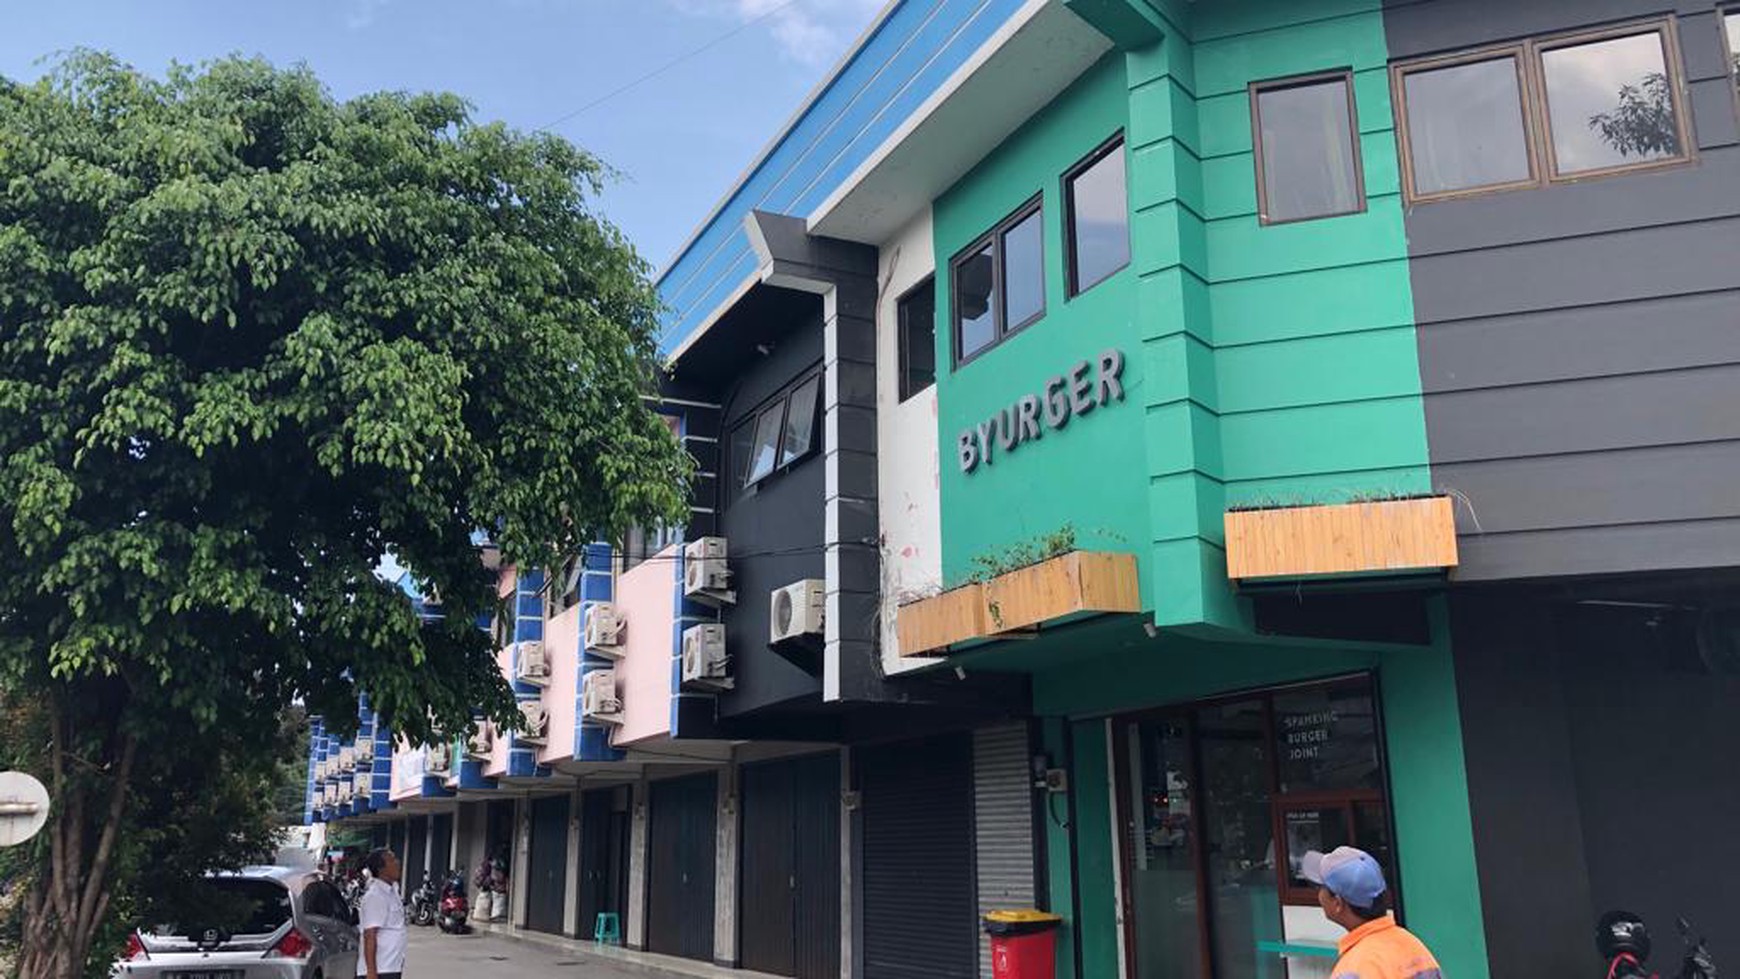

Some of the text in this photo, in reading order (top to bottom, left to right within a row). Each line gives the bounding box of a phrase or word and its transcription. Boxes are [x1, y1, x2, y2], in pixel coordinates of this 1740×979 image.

[957, 348, 1126, 475] BYURGER
[1287, 729, 1328, 744] BURGER
[1289, 746, 1319, 759] JOINT
